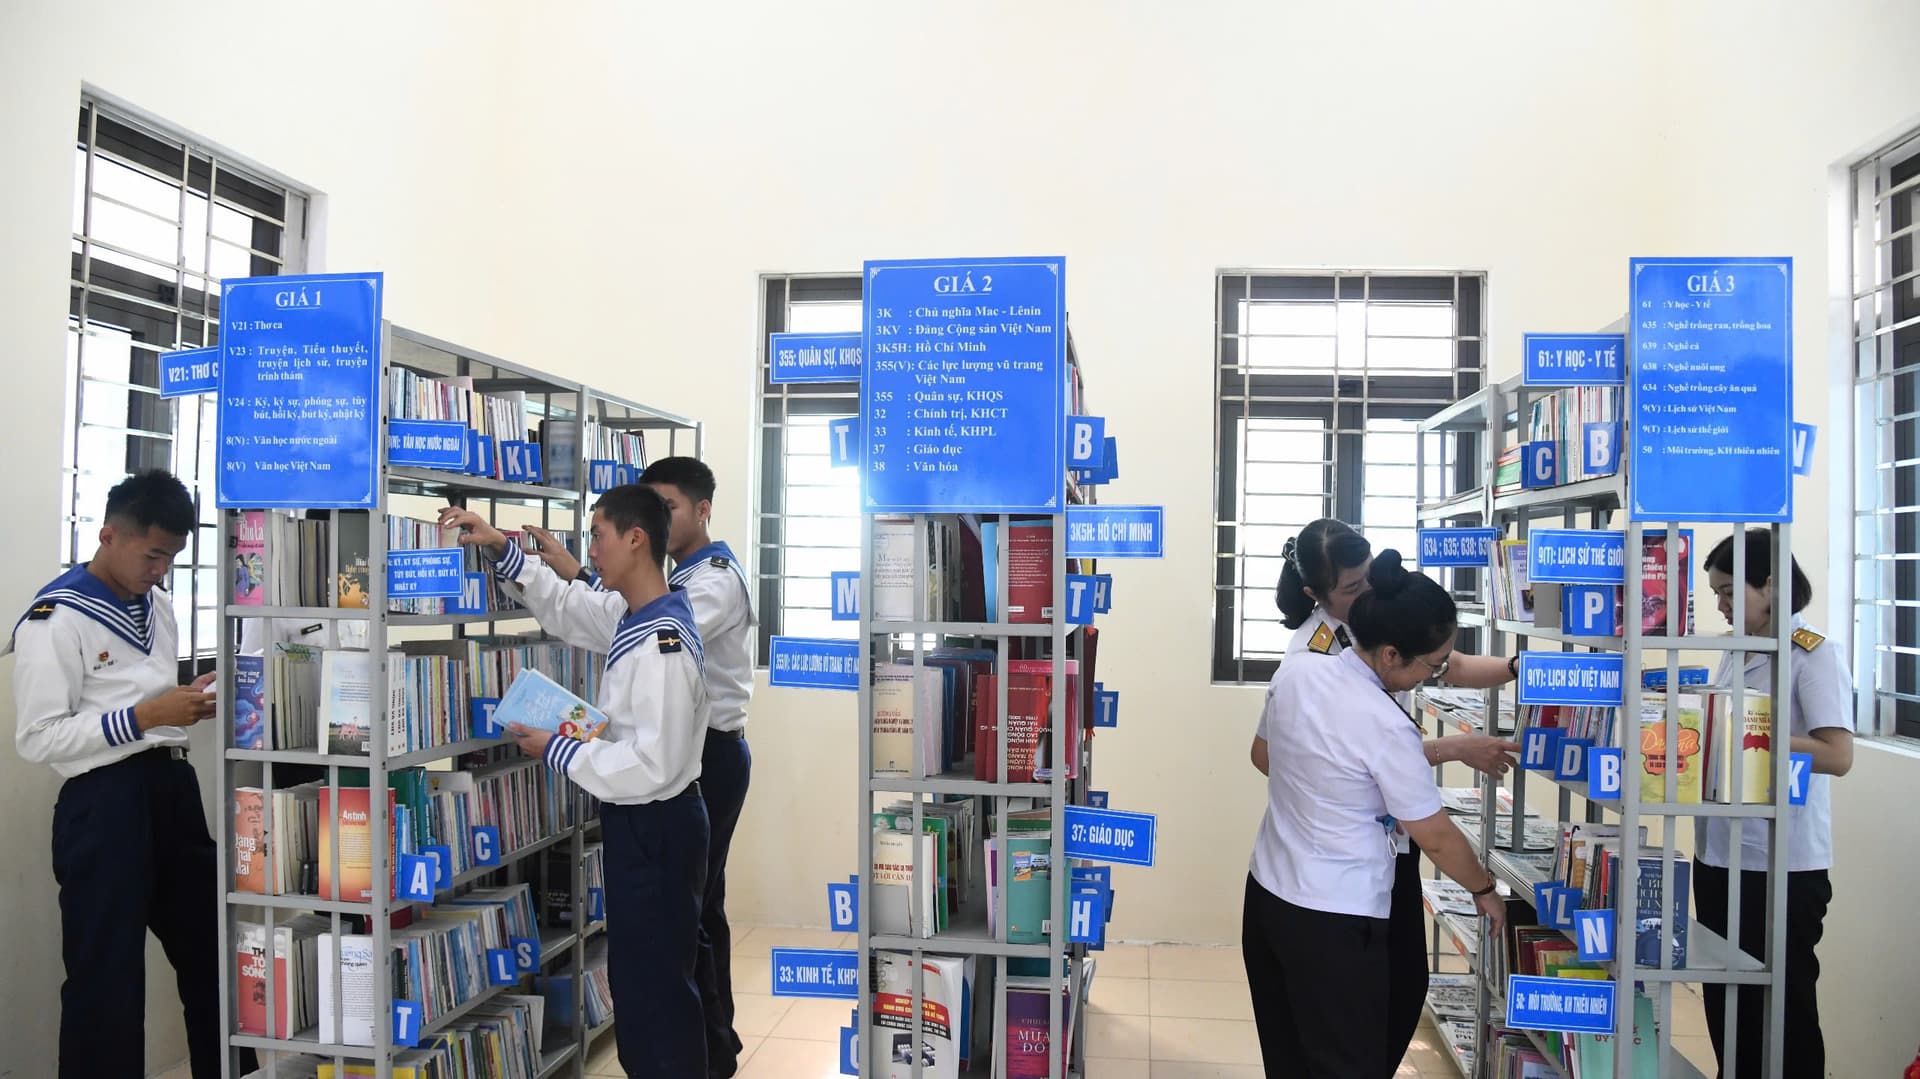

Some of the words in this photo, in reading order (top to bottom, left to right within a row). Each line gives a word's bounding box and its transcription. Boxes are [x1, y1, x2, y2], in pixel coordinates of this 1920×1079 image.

[933, 271, 975, 293] GIÁ
[982, 275, 992, 291] 2
[1687, 270, 1720, 293] GIÁ
[1726, 275, 1735, 292] 3
[276, 287, 309, 307] GIÁ
[315, 290, 321, 306] 1
[877, 308, 892, 318] 3K
[942, 306, 972, 319] nghĩa
[1009, 305, 1041, 316] Lênin
[232, 321, 247, 330] V21
[876, 325, 900, 335] 3KV
[947, 324, 975, 337] Cộng
[1000, 322, 1022, 336] Việt
[1025, 323, 1052, 333] Nam
[230, 347, 246, 356] V23
[779, 350, 797, 367] 355:
[798, 344, 821, 368] QUÂN
[839, 347, 861, 366] KHQS
[915, 340, 931, 352] Hồ
[934, 342, 954, 352] Chí
[958, 342, 986, 352] Minh
[1538, 350, 1554, 368] 61:
[1556, 350, 1564, 368] Y
[1565, 350, 1586, 372] HỌC
[1595, 350, 1602, 368] Y
[1604, 344, 1616, 368] TẾ
[169, 366, 189, 383] V21:
[191, 361, 210, 380] THƠ
[258, 358, 288, 370] truyện
[336, 357, 368, 368] truyện
[918, 359, 939, 370] Các
[942, 360, 959, 372] lực
[962, 359, 993, 372] lượng
[1013, 360, 1043, 372] trang
[915, 373, 936, 386] Việt
[940, 374, 966, 384] Nam
[228, 398, 244, 407] V24
[874, 392, 893, 401] 355
[914, 391, 944, 402] Quân
[967, 391, 1003, 401] KHQS
[1716, 405, 1736, 413] Nam
[874, 409, 886, 419] 32
[914, 409, 948, 419] Chính
[971, 408, 1008, 419] KHCT
[834, 425, 849, 462] T
[874, 427, 886, 437] 33
[914, 426, 941, 437] Kinh
[960, 426, 996, 436] KHPL
[1073, 423, 1092, 460] B
[506, 446, 522, 475] K
[872, 445, 885, 454] 37
[913, 444, 939, 455] Giáo
[942, 444, 962, 456] dục
[1590, 430, 1609, 467] B
[255, 462, 272, 471] Văn
[274, 462, 289, 472] học
[290, 461, 308, 472] Việt
[310, 462, 331, 470] Nam
[525, 449, 536, 478] L
[872, 462, 886, 471] 38
[913, 462, 935, 472] Văn
[939, 462, 959, 472] hóa
[1535, 447, 1552, 480] C
[594, 465, 612, 490] M
[1070, 523, 1095, 542] 3K5H:
[1112, 518, 1127, 542] CHÍ
[1129, 523, 1153, 542] MINH
[1538, 545, 1556, 566] 9(T):
[1558, 546, 1576, 570] LỊCH
[1578, 542, 1589, 566] SỬ
[1591, 542, 1606, 566] THẾ
[459, 578, 480, 609] M
[837, 578, 860, 614] M
[1070, 582, 1087, 617] T
[1094, 582, 1107, 608] H
[1584, 592, 1604, 629] P
[1527, 669, 1546, 688] 9(Y):
[1548, 669, 1566, 690] LỊCH
[1568, 664, 1580, 687] SỬ
[1581, 667, 1598, 691] VIỆT
[1600, 670, 1619, 688] NAM
[483, 704, 496, 734] T
[1101, 696, 1115, 722] T
[1526, 733, 1546, 765] H
[1561, 744, 1582, 776] D
[1600, 755, 1620, 792] B
[475, 832, 491, 861] C
[1072, 824, 1087, 843] 37:
[1088, 823, 1112, 844] GIÁO
[1114, 827, 1135, 852] DỤC
[410, 862, 429, 896] A
[834, 890, 853, 925] B
[1070, 901, 1091, 937] H
[1555, 895, 1571, 925] L
[1582, 917, 1608, 954] N
[497, 954, 512, 981] L
[518, 942, 532, 968] S
[780, 966, 794, 983] 33:
[796, 967, 819, 984] KINH
[821, 962, 835, 987] TẾ,
[397, 1006, 412, 1040] T
